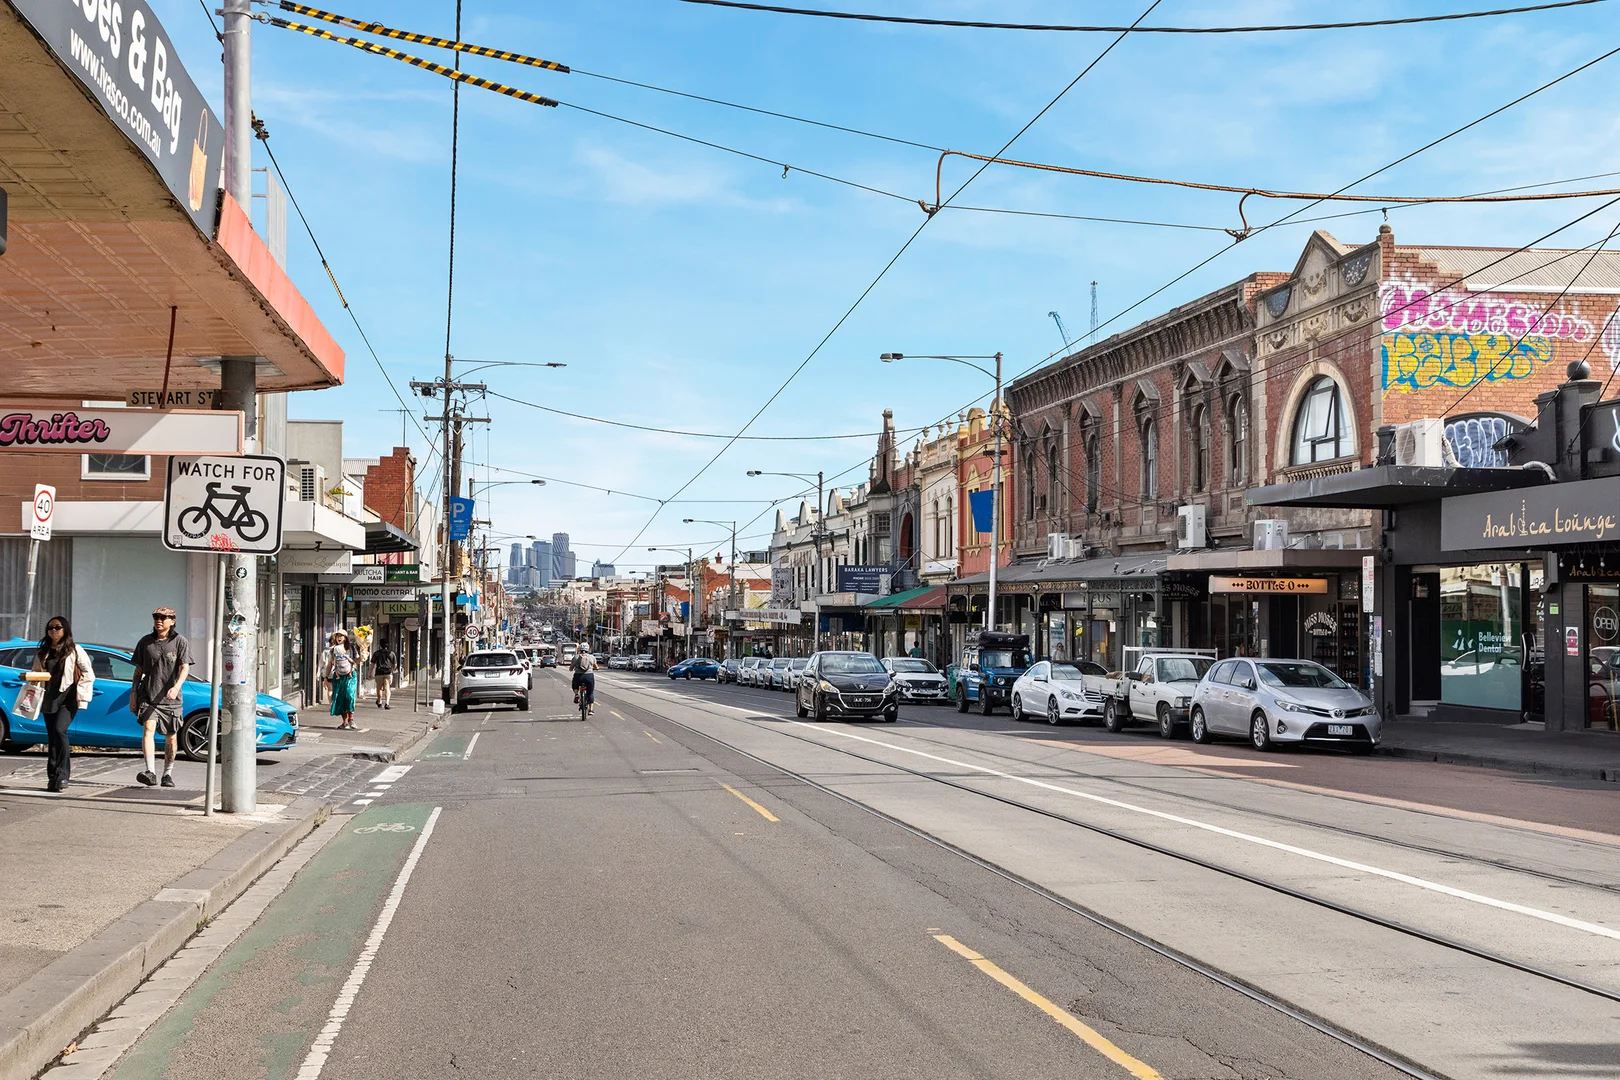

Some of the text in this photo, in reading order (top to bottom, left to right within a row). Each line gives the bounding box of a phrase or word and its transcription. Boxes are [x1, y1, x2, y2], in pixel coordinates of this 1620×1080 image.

[128, 9, 147, 91] &
[151, 35, 182, 155] Bag
[70, 28, 161, 159] www.ivasco.com.au
[131, 391, 191, 405] STEWART
[0, 412, 110, 446] Thrifter
[178, 461, 275, 482] WATCH FOR
[37, 498, 50, 514] 40
[453, 502, 466, 518] P
[32, 525, 49, 536] AREA
[281, 555, 349, 568] Princess Boutique
[354, 588, 414, 596] MOMO CENTRAL
[389, 603, 407, 612] KIN
[1594, 616, 1617, 631] OPEN
[467, 628, 477, 636] 40
[1479, 631, 1512, 643] Belleview
[1479, 642, 1502, 653] Dental
